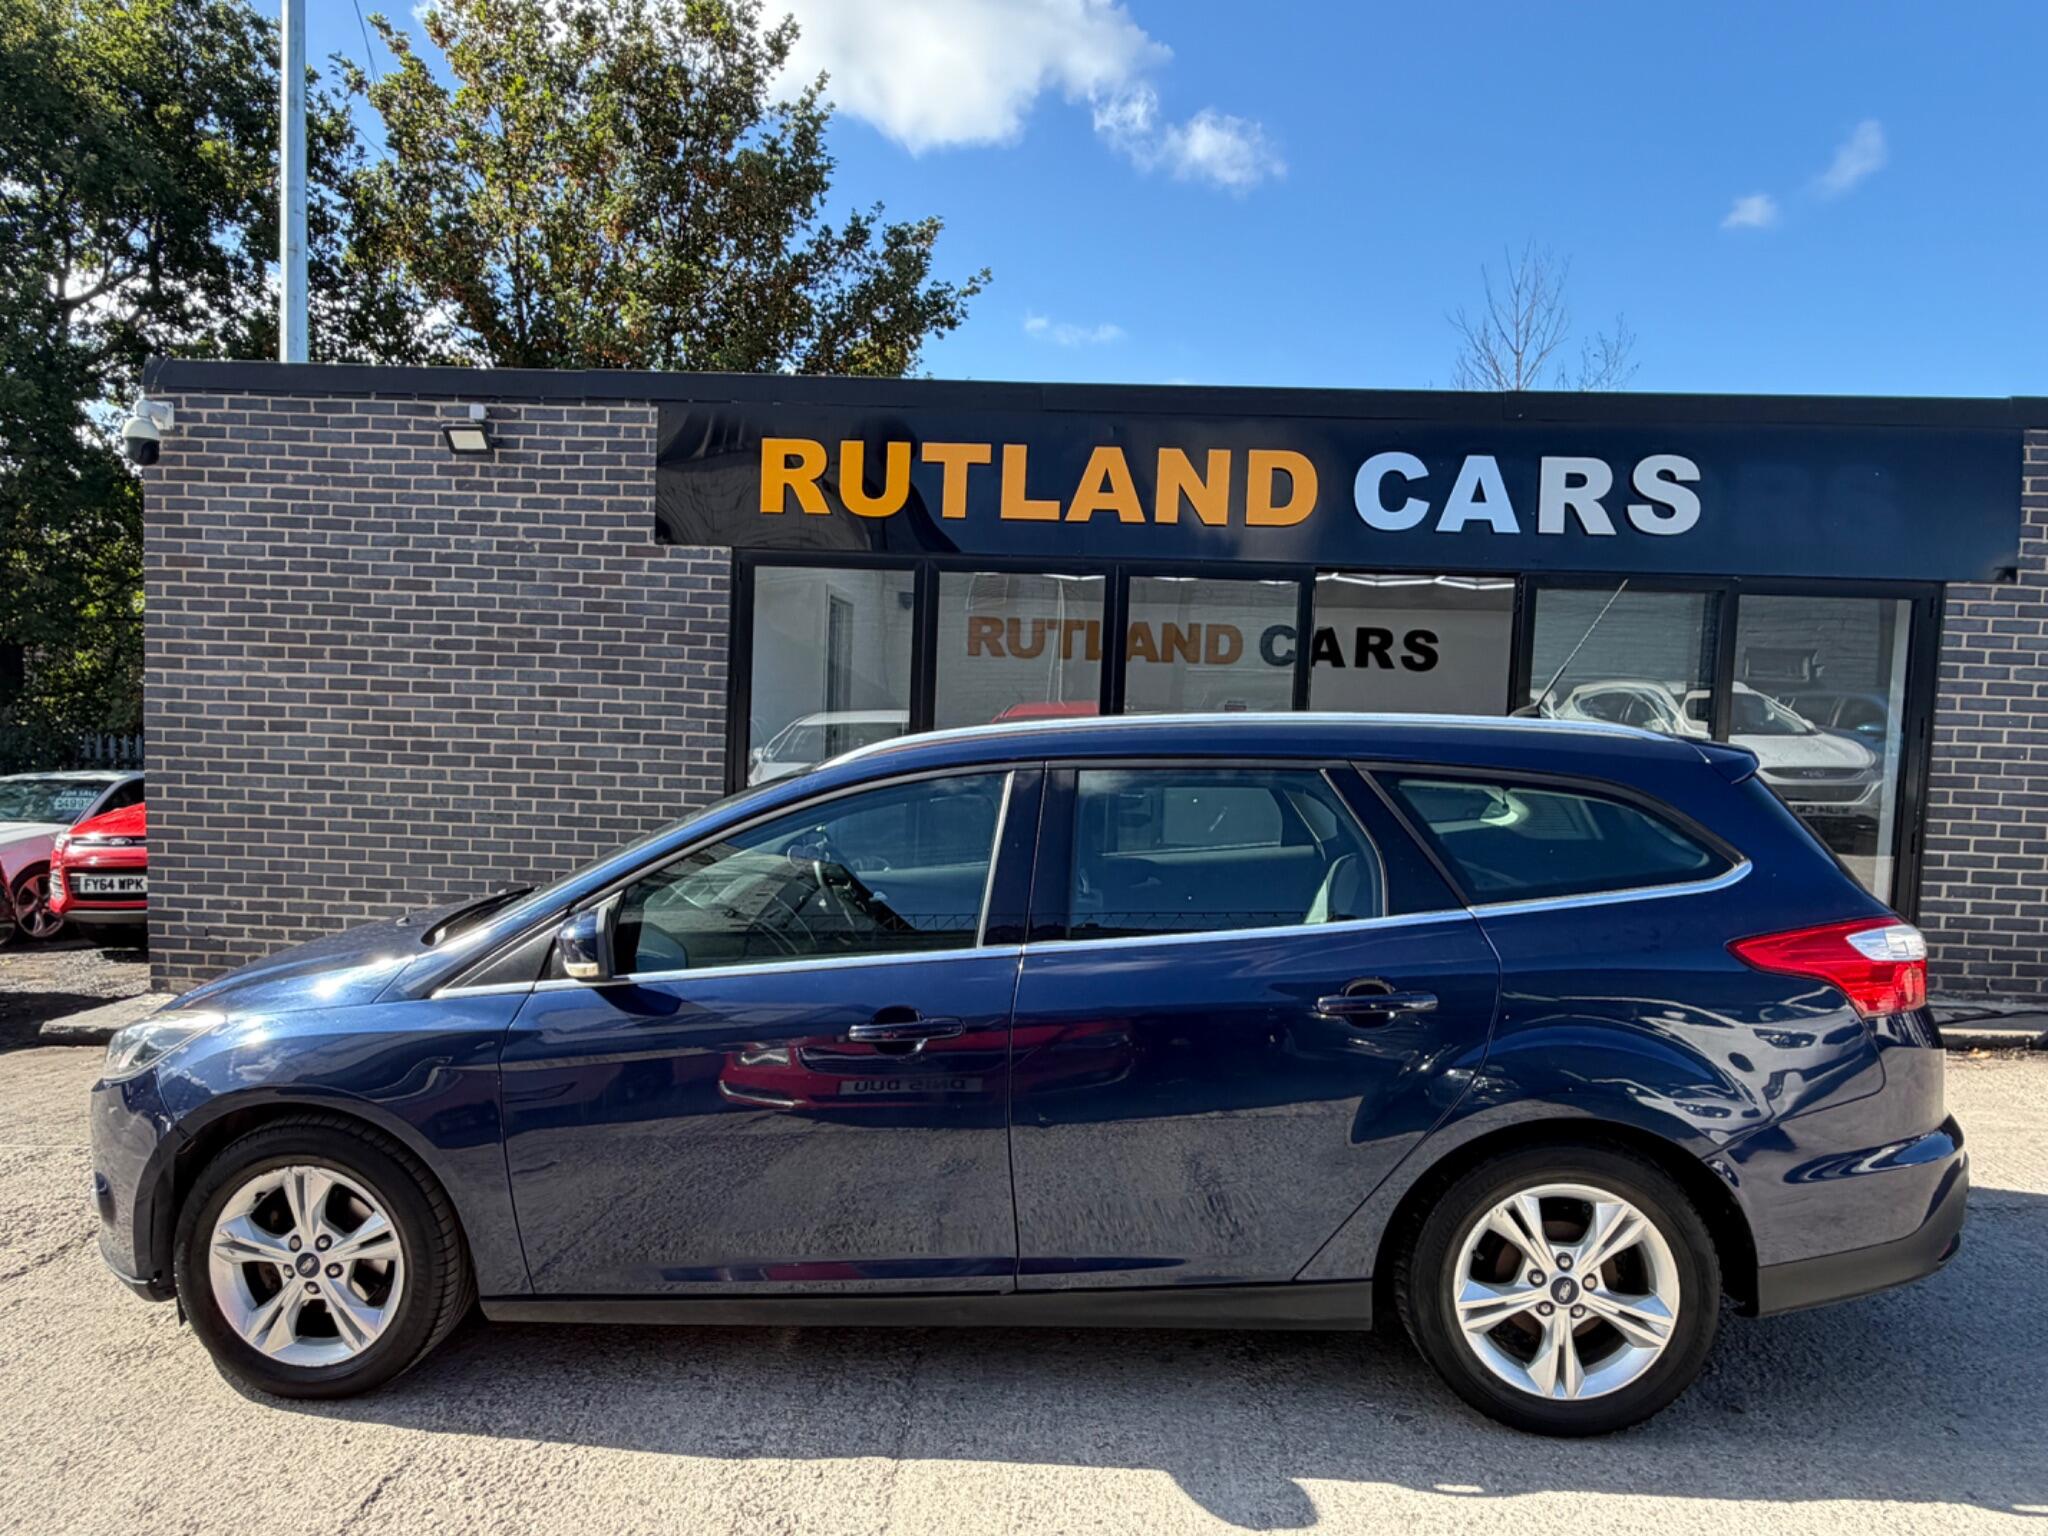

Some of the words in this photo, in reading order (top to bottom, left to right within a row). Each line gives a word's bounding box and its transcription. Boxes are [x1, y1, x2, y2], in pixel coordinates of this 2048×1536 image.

[759, 437, 1319, 527] RUTLAND
[1353, 450, 1702, 536] CARS
[967, 615, 1244, 666] RUTLAND
[1259, 624, 1440, 673] CARS
[84, 878, 115, 891] FY64
[118, 878, 144, 891] WPK
